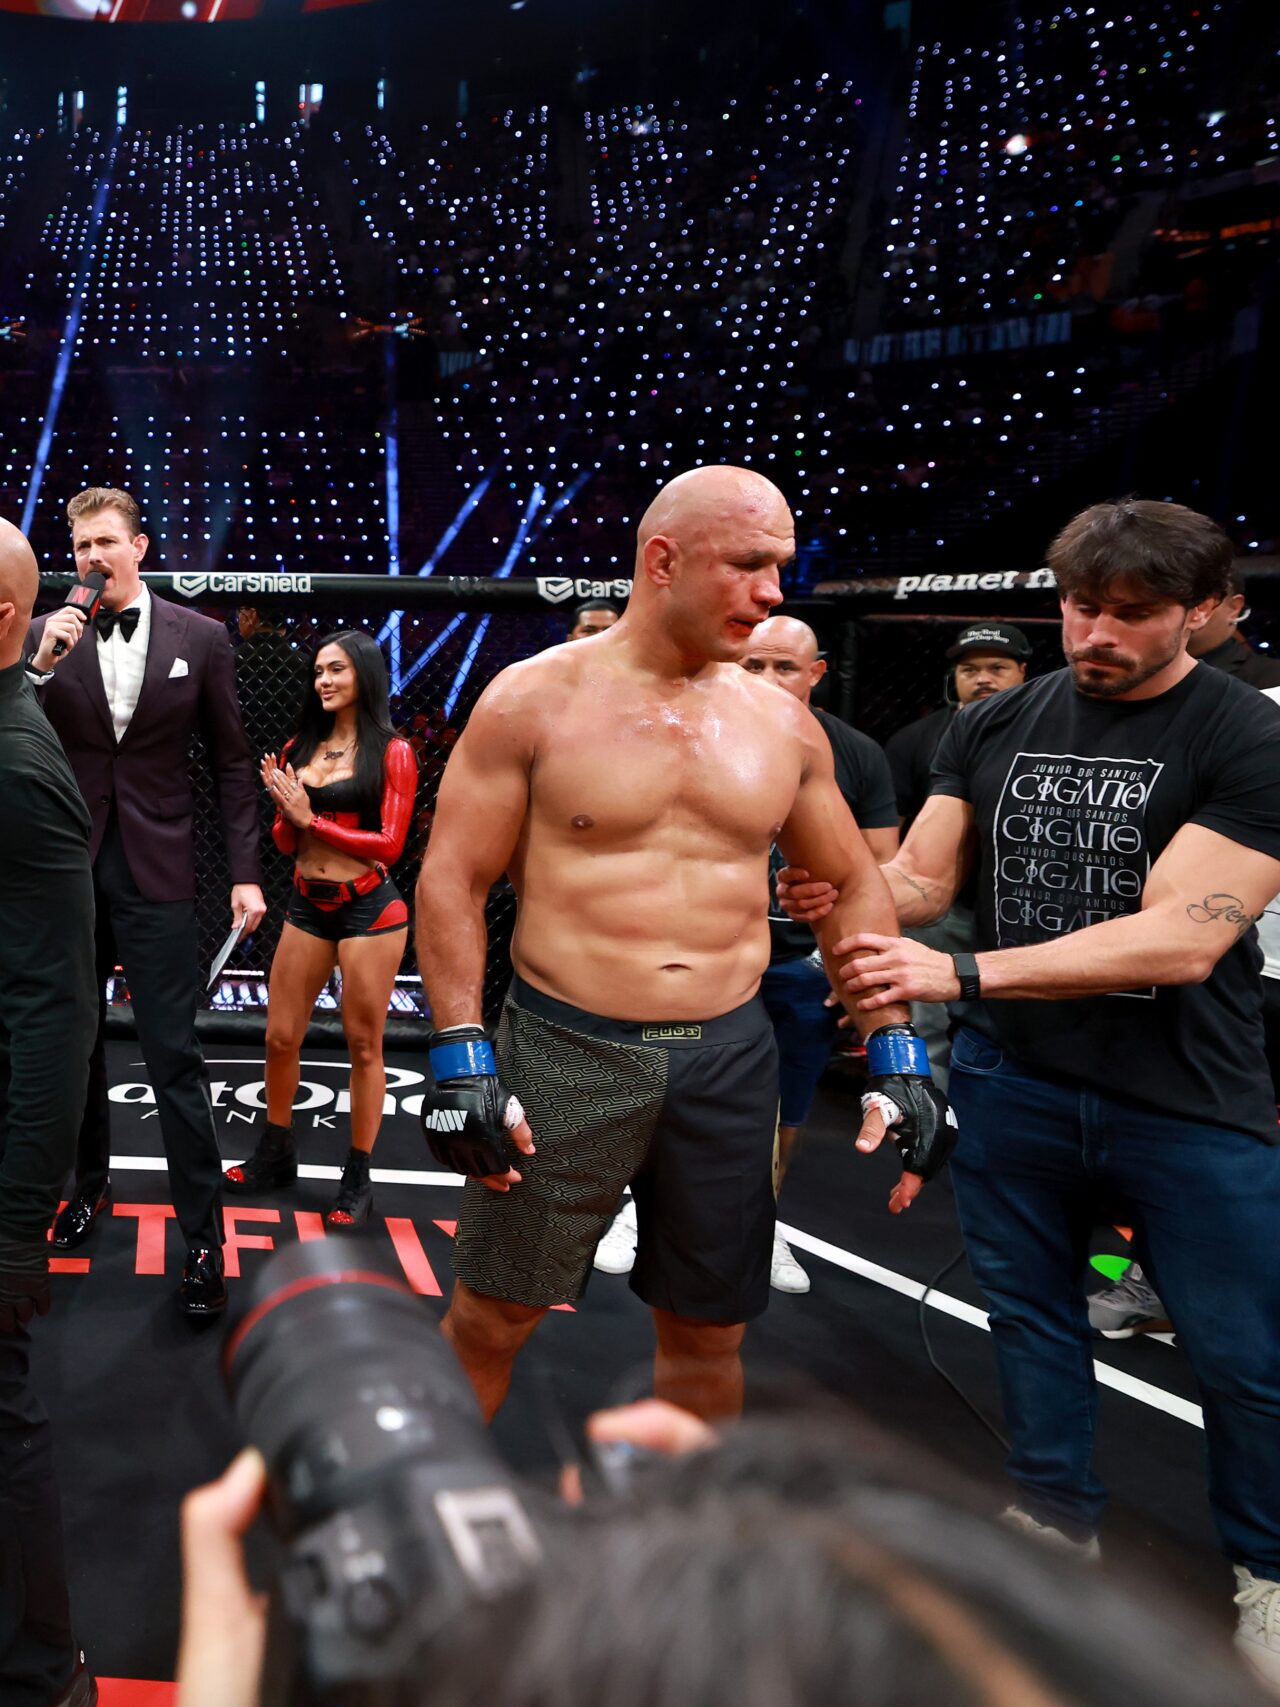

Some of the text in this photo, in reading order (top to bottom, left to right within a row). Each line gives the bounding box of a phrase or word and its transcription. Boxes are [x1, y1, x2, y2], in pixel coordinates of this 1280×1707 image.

[209, 574, 312, 593] CarShield
[894, 570, 1019, 600] planet
[1032, 763, 1072, 775] JUNIOR
[1100, 768, 1143, 781] SANTOS
[1020, 803, 1063, 815] JUNIOR
[1085, 808, 1129, 823] SANTOS
[1015, 845, 1057, 859] JUNIOR
[1084, 898, 1125, 911] ANTOS
